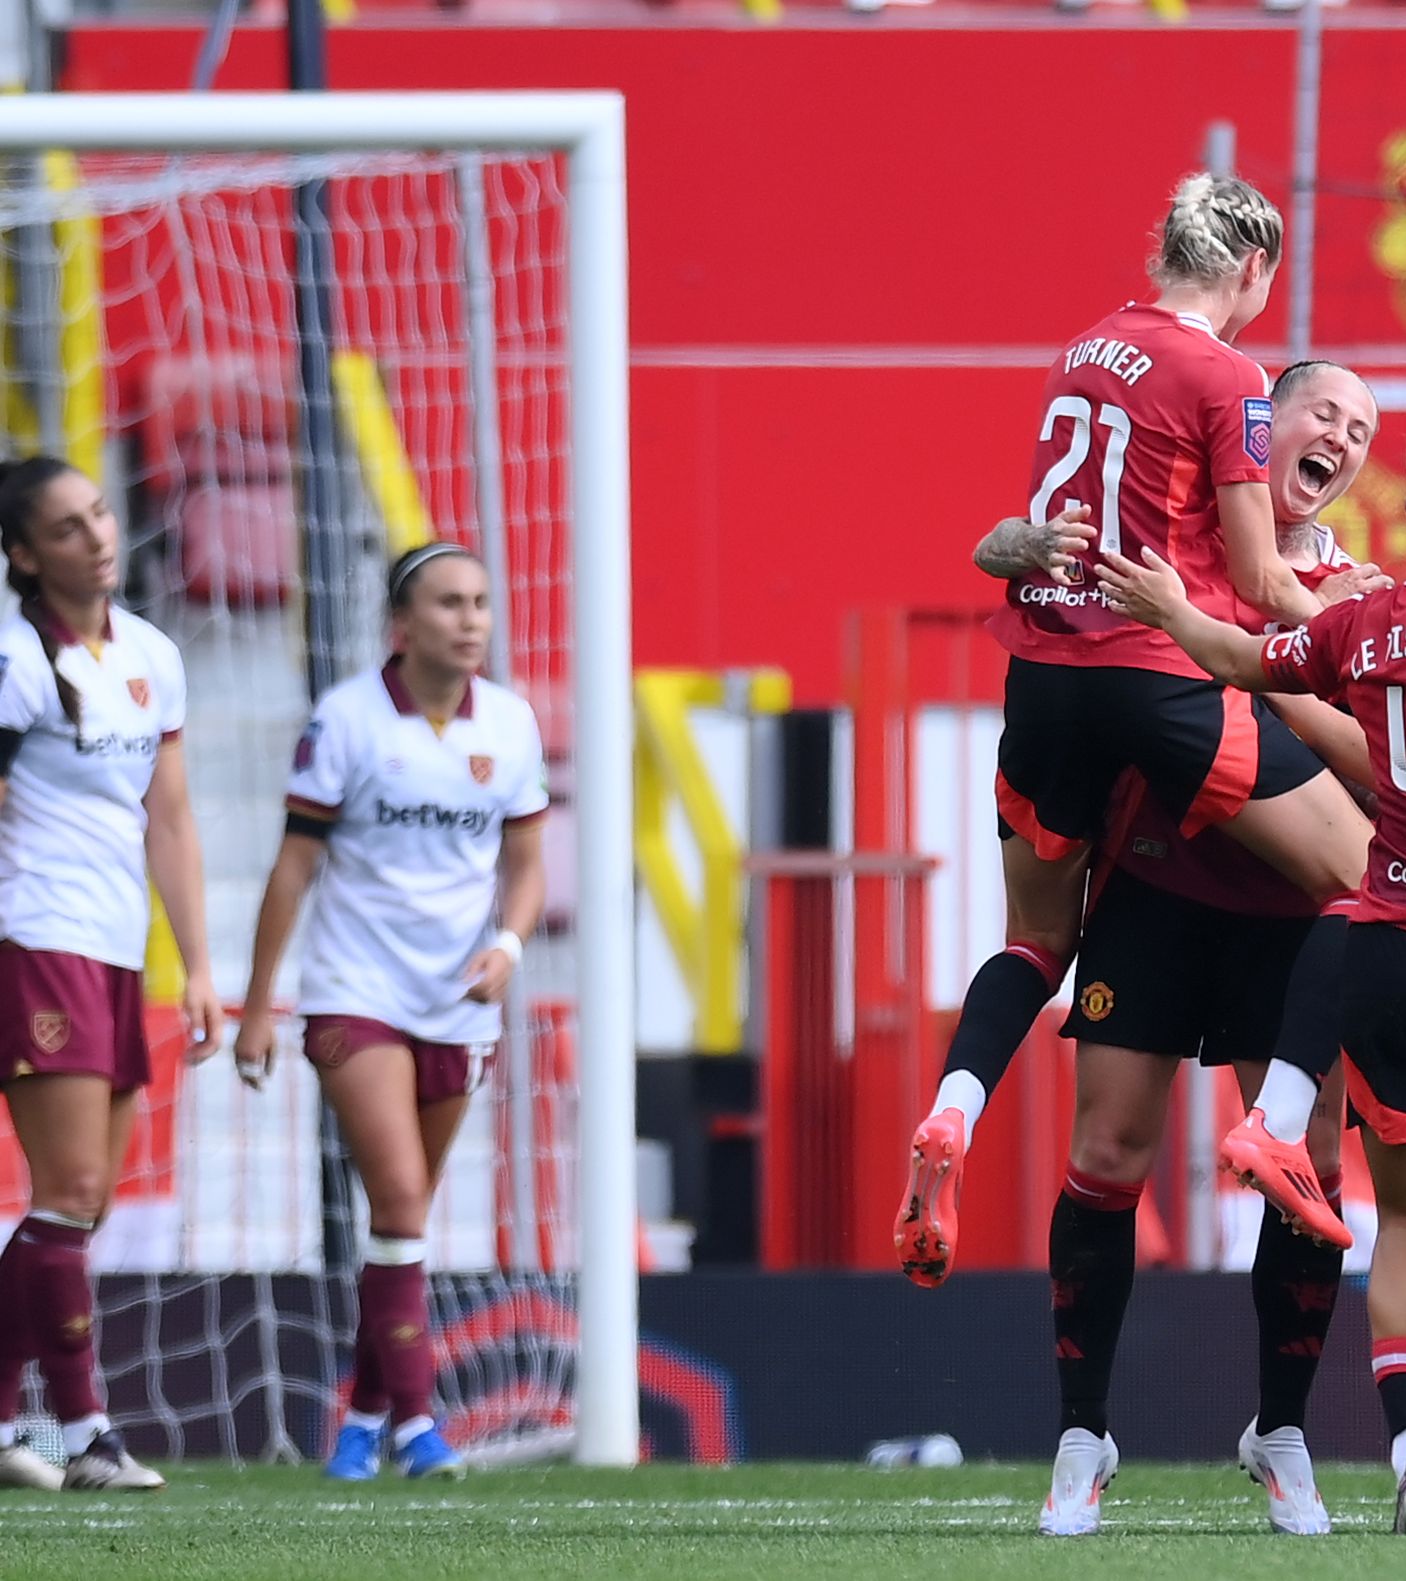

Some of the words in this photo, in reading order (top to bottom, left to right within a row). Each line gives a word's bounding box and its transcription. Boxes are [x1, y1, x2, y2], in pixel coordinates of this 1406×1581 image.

[1064, 337, 1153, 387] TURNER
[1029, 395, 1132, 556] 21
[1020, 584, 1111, 608] Copilot+
[1350, 638, 1377, 681] LE
[375, 797, 496, 838] betway
